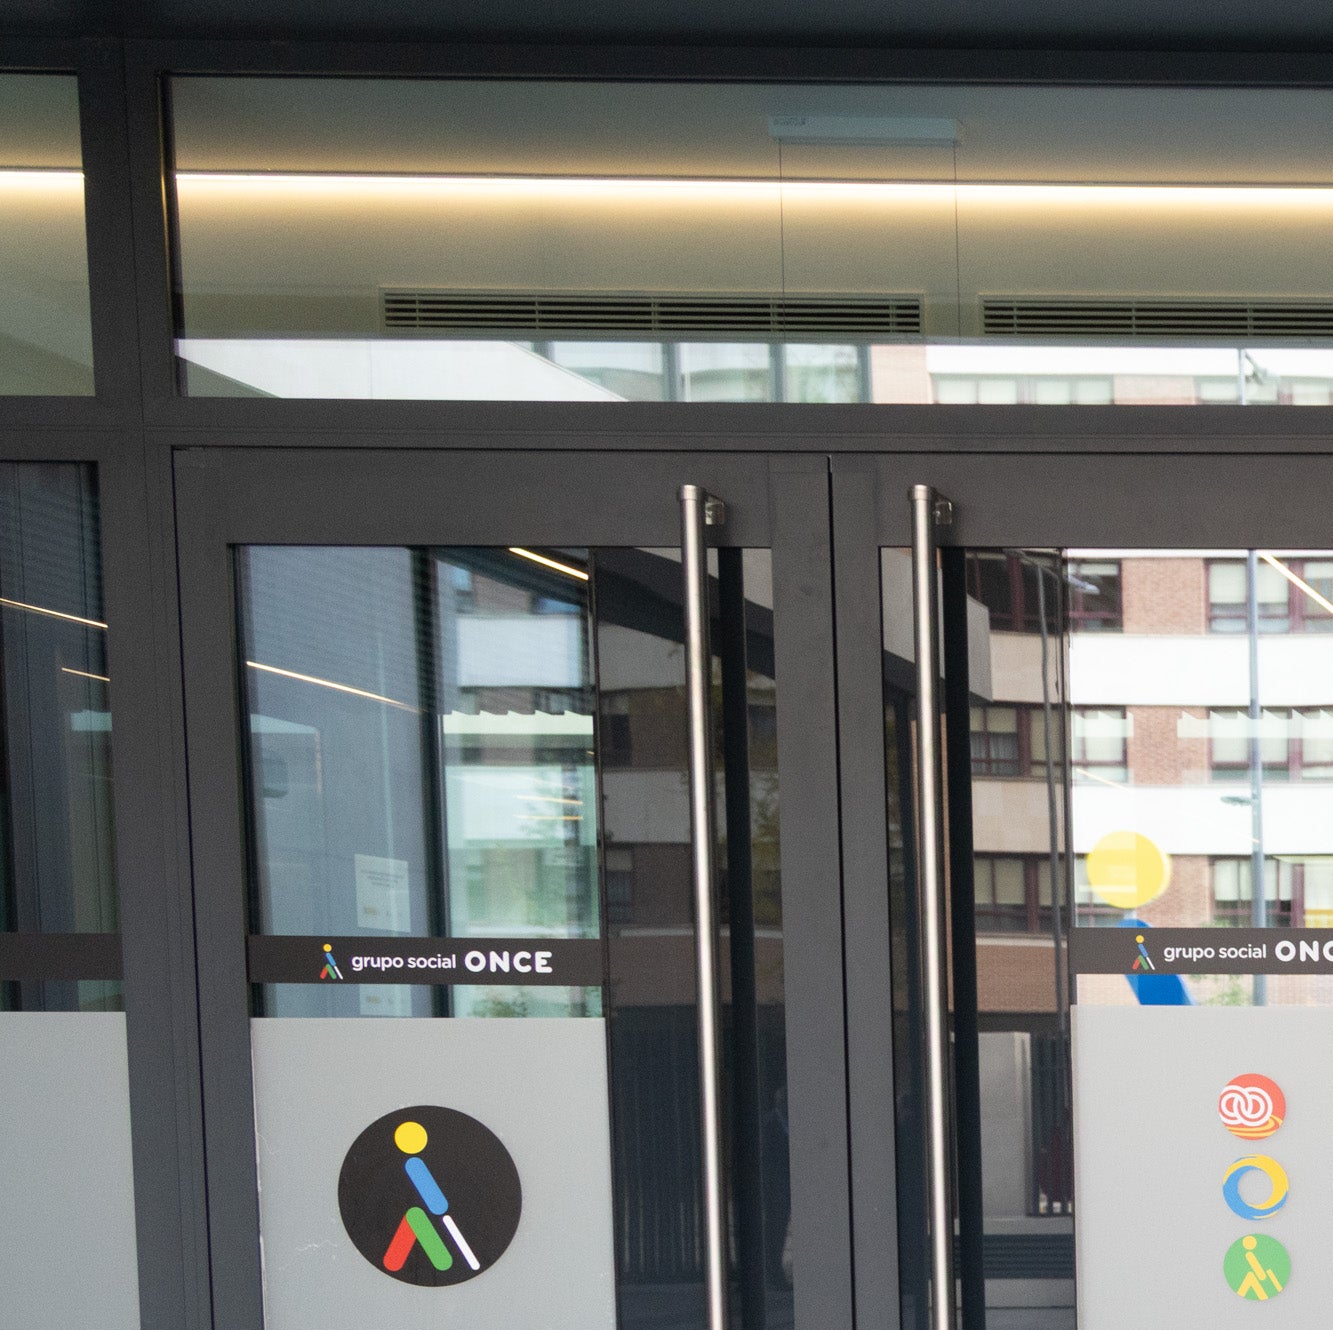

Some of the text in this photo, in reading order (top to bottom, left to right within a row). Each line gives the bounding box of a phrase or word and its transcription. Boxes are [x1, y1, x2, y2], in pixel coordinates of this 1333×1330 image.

[351, 950, 553, 974] grupo social ONCE
[1163, 945, 1216, 963] grupo
[1217, 943, 1267, 960] social
